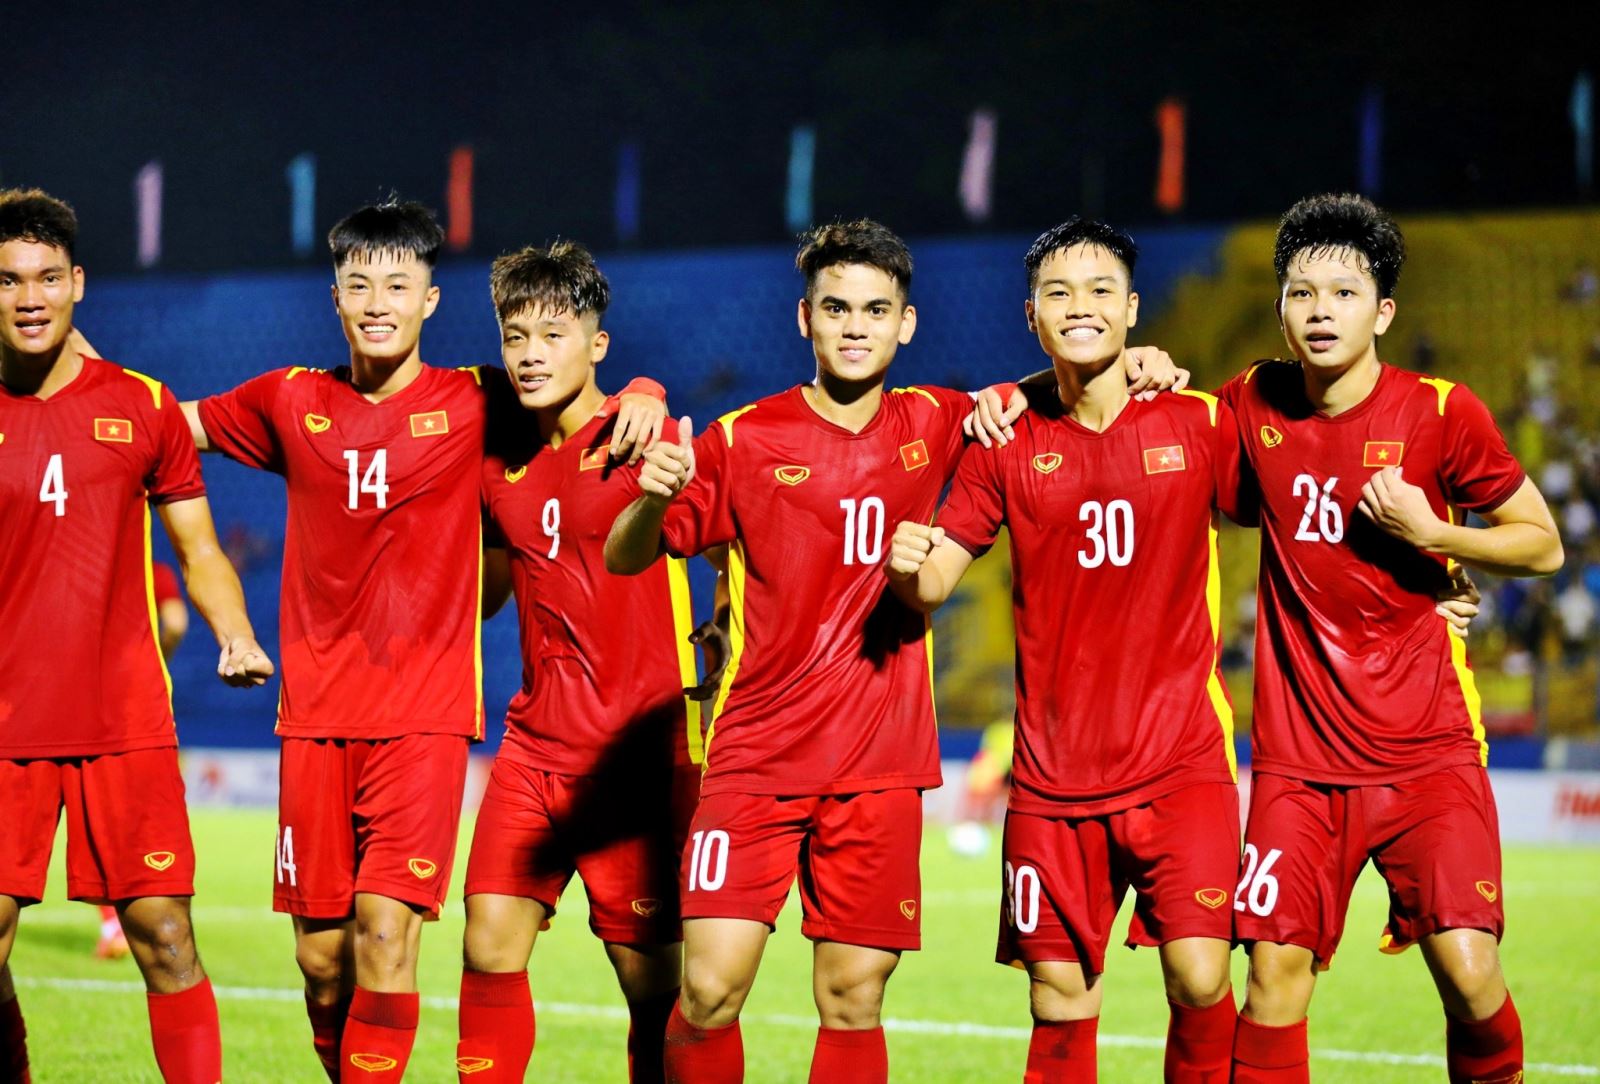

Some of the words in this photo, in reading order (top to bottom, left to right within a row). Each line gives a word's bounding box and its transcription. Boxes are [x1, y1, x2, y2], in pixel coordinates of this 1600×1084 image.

[40, 453, 69, 517] 4
[342, 448, 390, 510] 14
[1292, 473, 1344, 544] 26
[541, 497, 561, 560] 9
[839, 496, 886, 566] 10
[1077, 499, 1135, 569] 30
[688, 829, 730, 892] 10
[1233, 843, 1283, 917] 26
